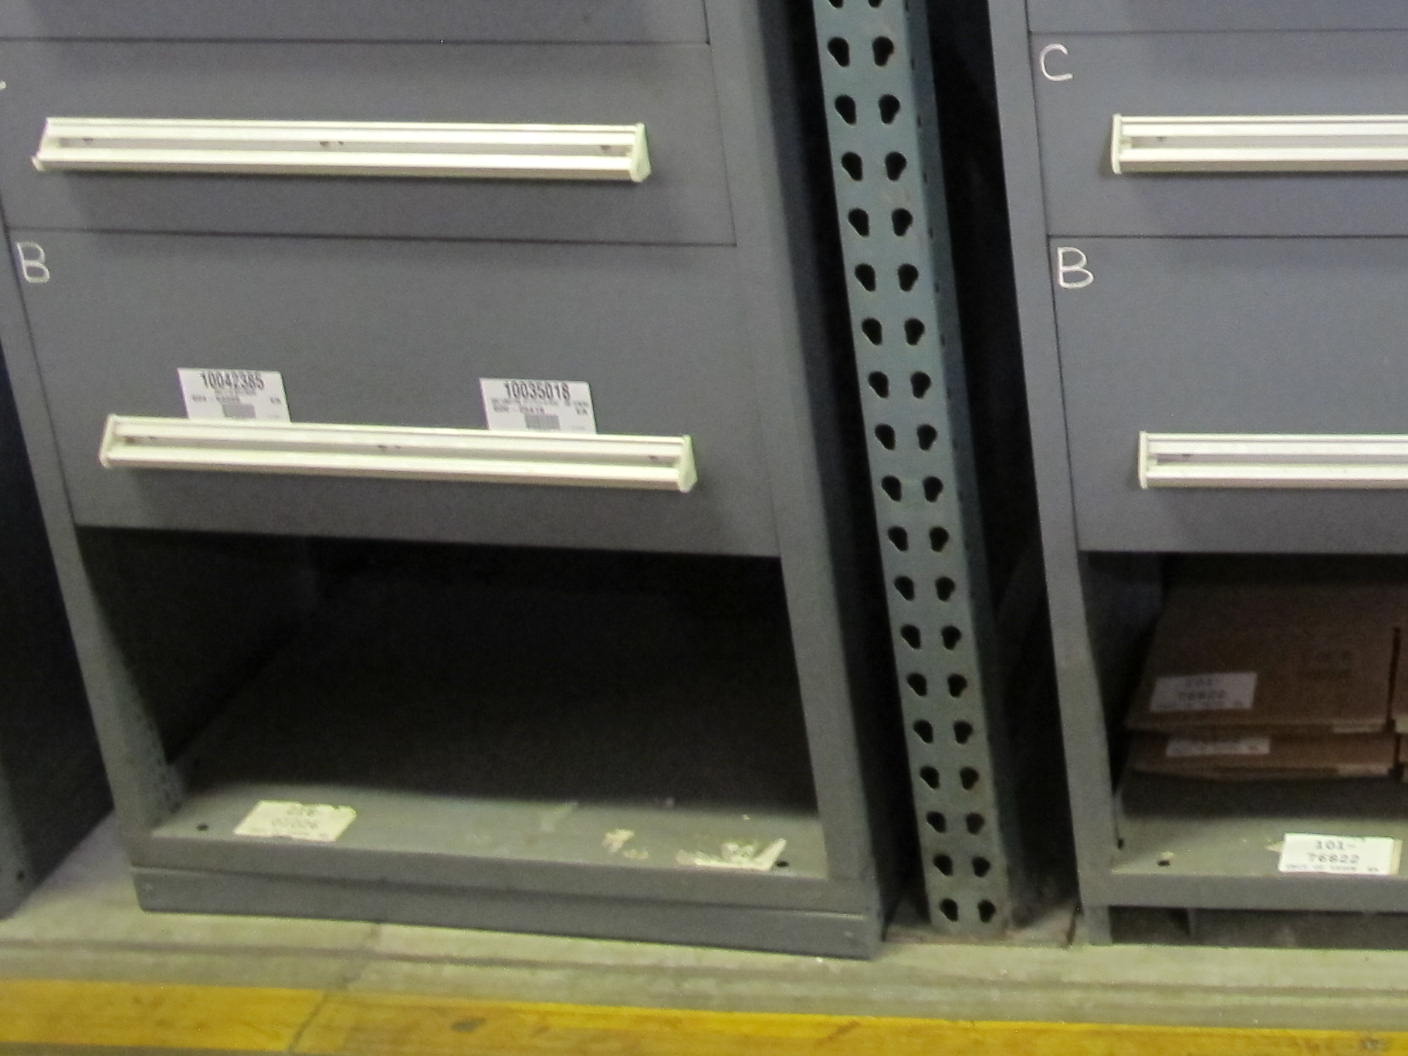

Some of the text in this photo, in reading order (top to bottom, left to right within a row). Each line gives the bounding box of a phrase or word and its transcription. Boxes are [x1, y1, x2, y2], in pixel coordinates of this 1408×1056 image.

[1039, 43, 1073, 82] C
[16, 241, 50, 284] B
[1056, 246, 1094, 289] B
